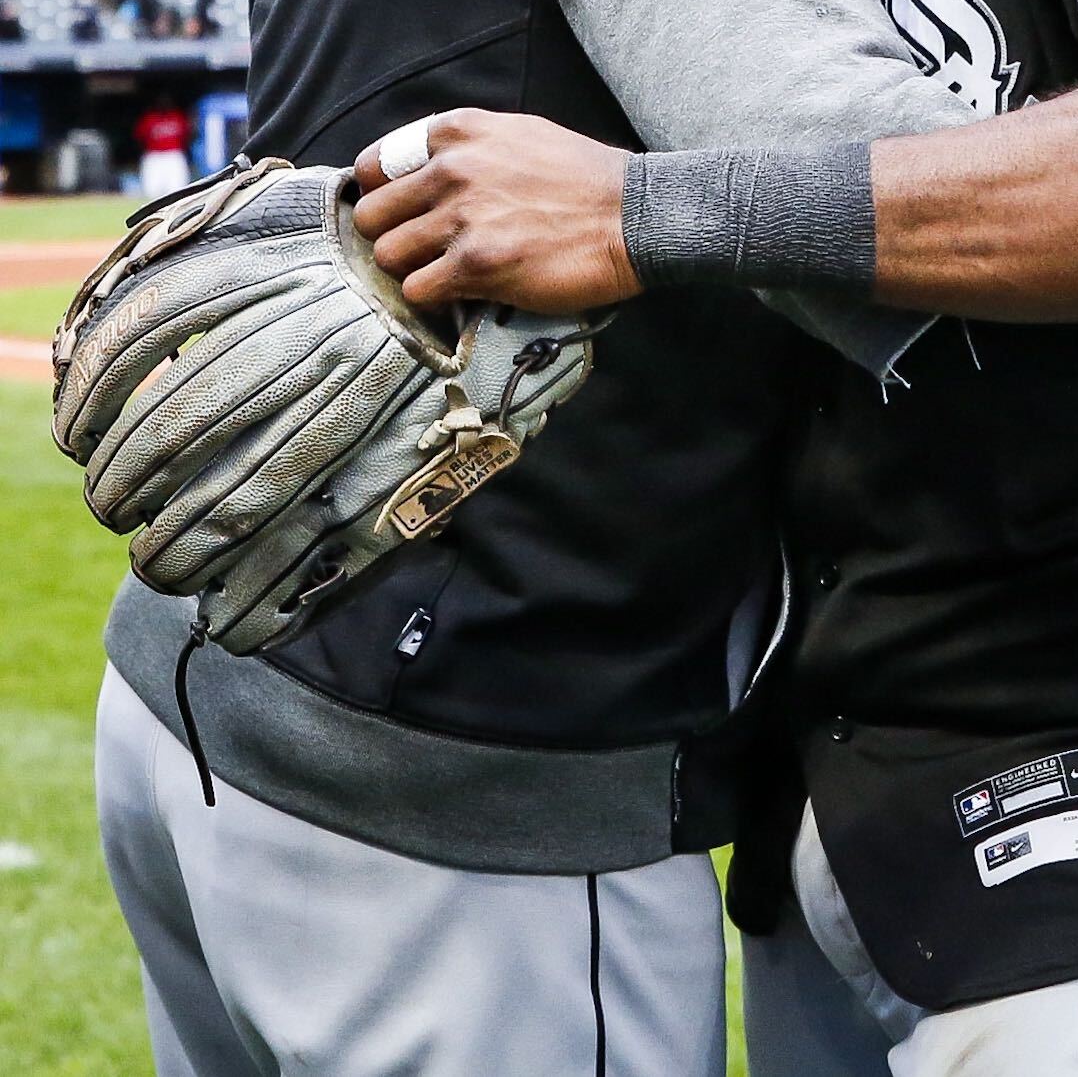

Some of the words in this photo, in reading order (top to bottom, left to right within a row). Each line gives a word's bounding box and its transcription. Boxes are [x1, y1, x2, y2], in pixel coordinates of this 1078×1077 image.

[456, 447, 493, 481] LIVES
[464, 449, 513, 490] MATTER
[995, 759, 1056, 786] ENGINEERED
